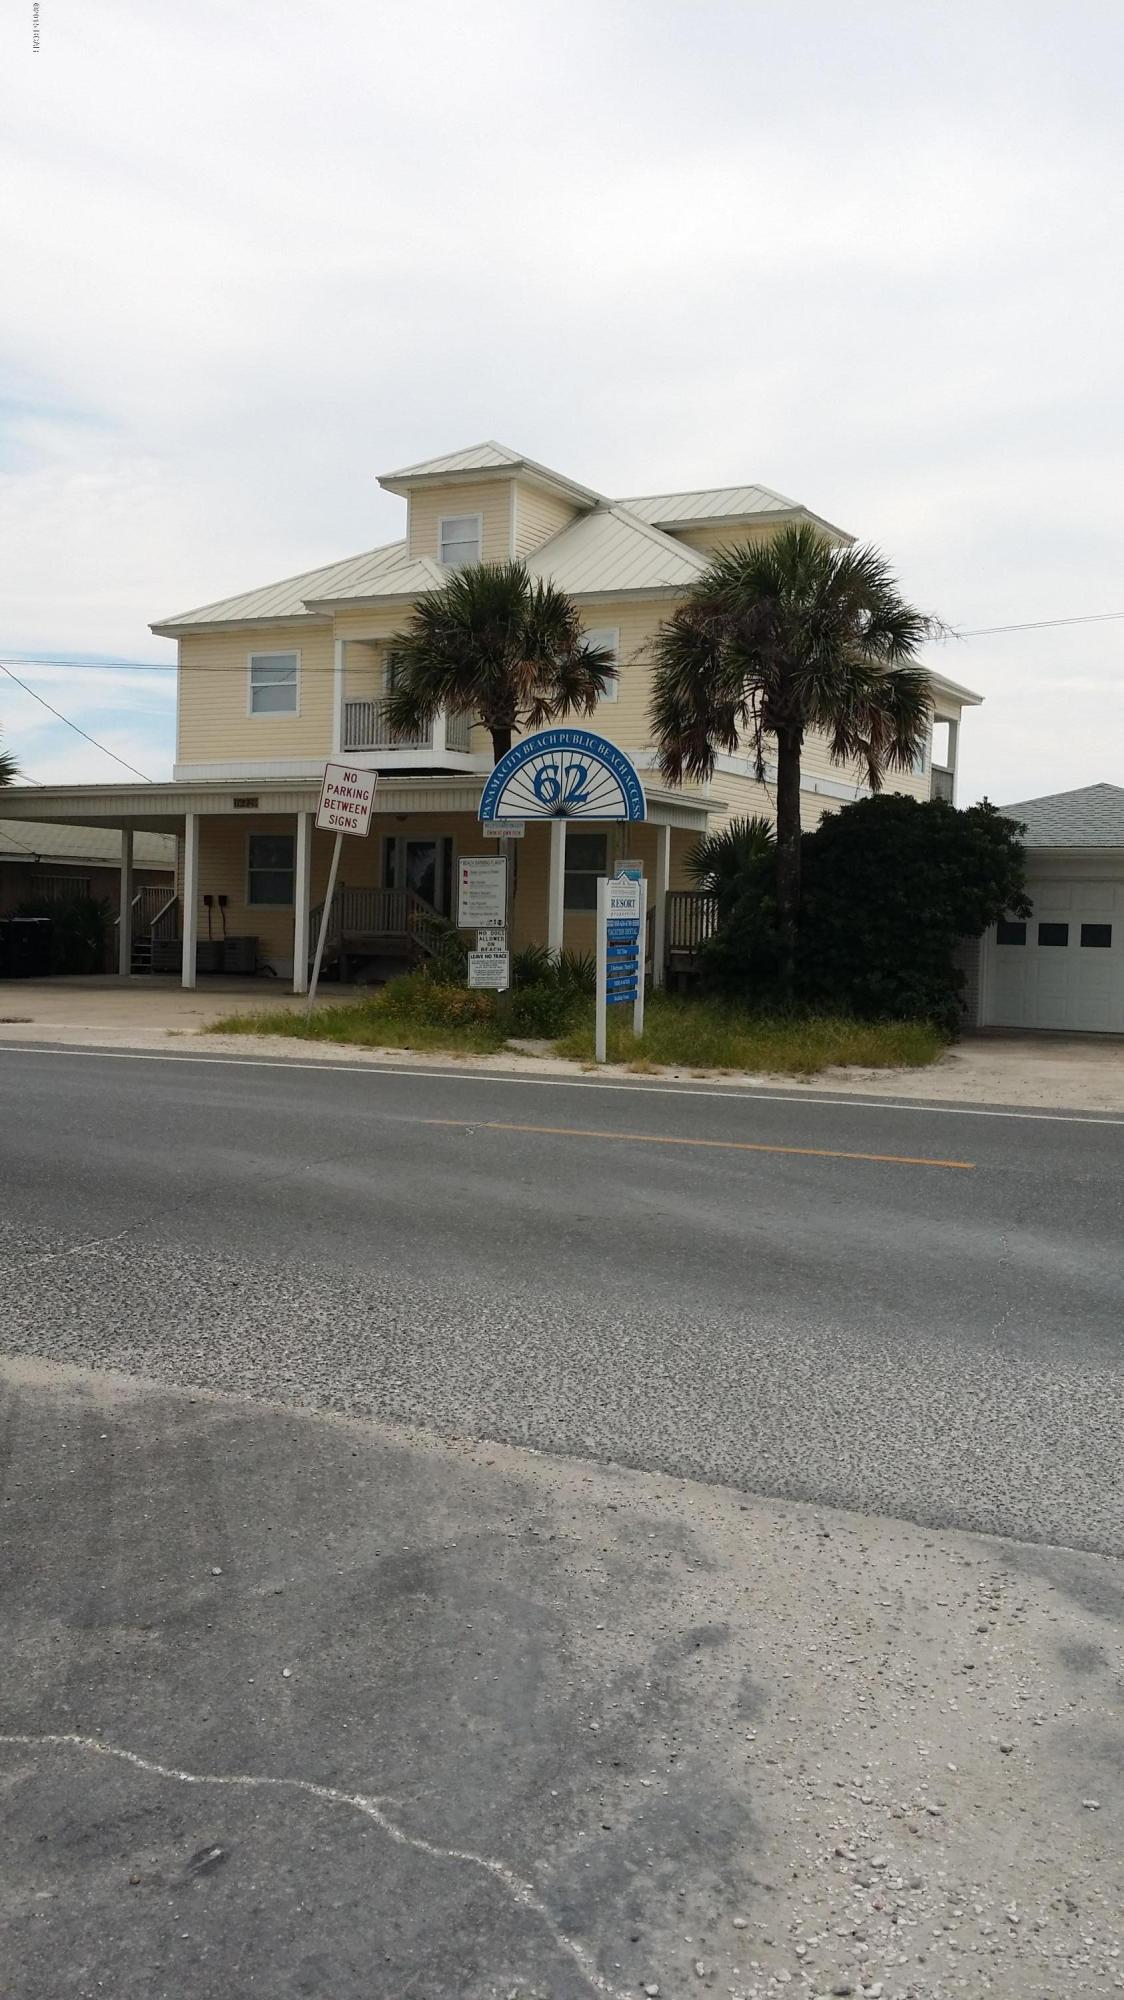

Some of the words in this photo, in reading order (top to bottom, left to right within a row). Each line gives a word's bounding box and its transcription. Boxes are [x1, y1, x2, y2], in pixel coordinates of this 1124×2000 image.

[343, 772, 358, 783] NO
[482, 773, 506, 819] PANAMA
[501, 752, 522, 773] CITY
[523, 734, 557, 754] BEACH
[559, 733, 598, 749] PUBLIC
[598, 744, 628, 775] BEACH
[623, 775, 641, 819] ACCESS
[533, 763, 591, 805] 62
[326, 783, 370, 801] PARKING
[323, 798, 368, 816] BETWEEN
[328, 814, 358, 829] SIGNS
[610, 899, 636, 908] RESORT
